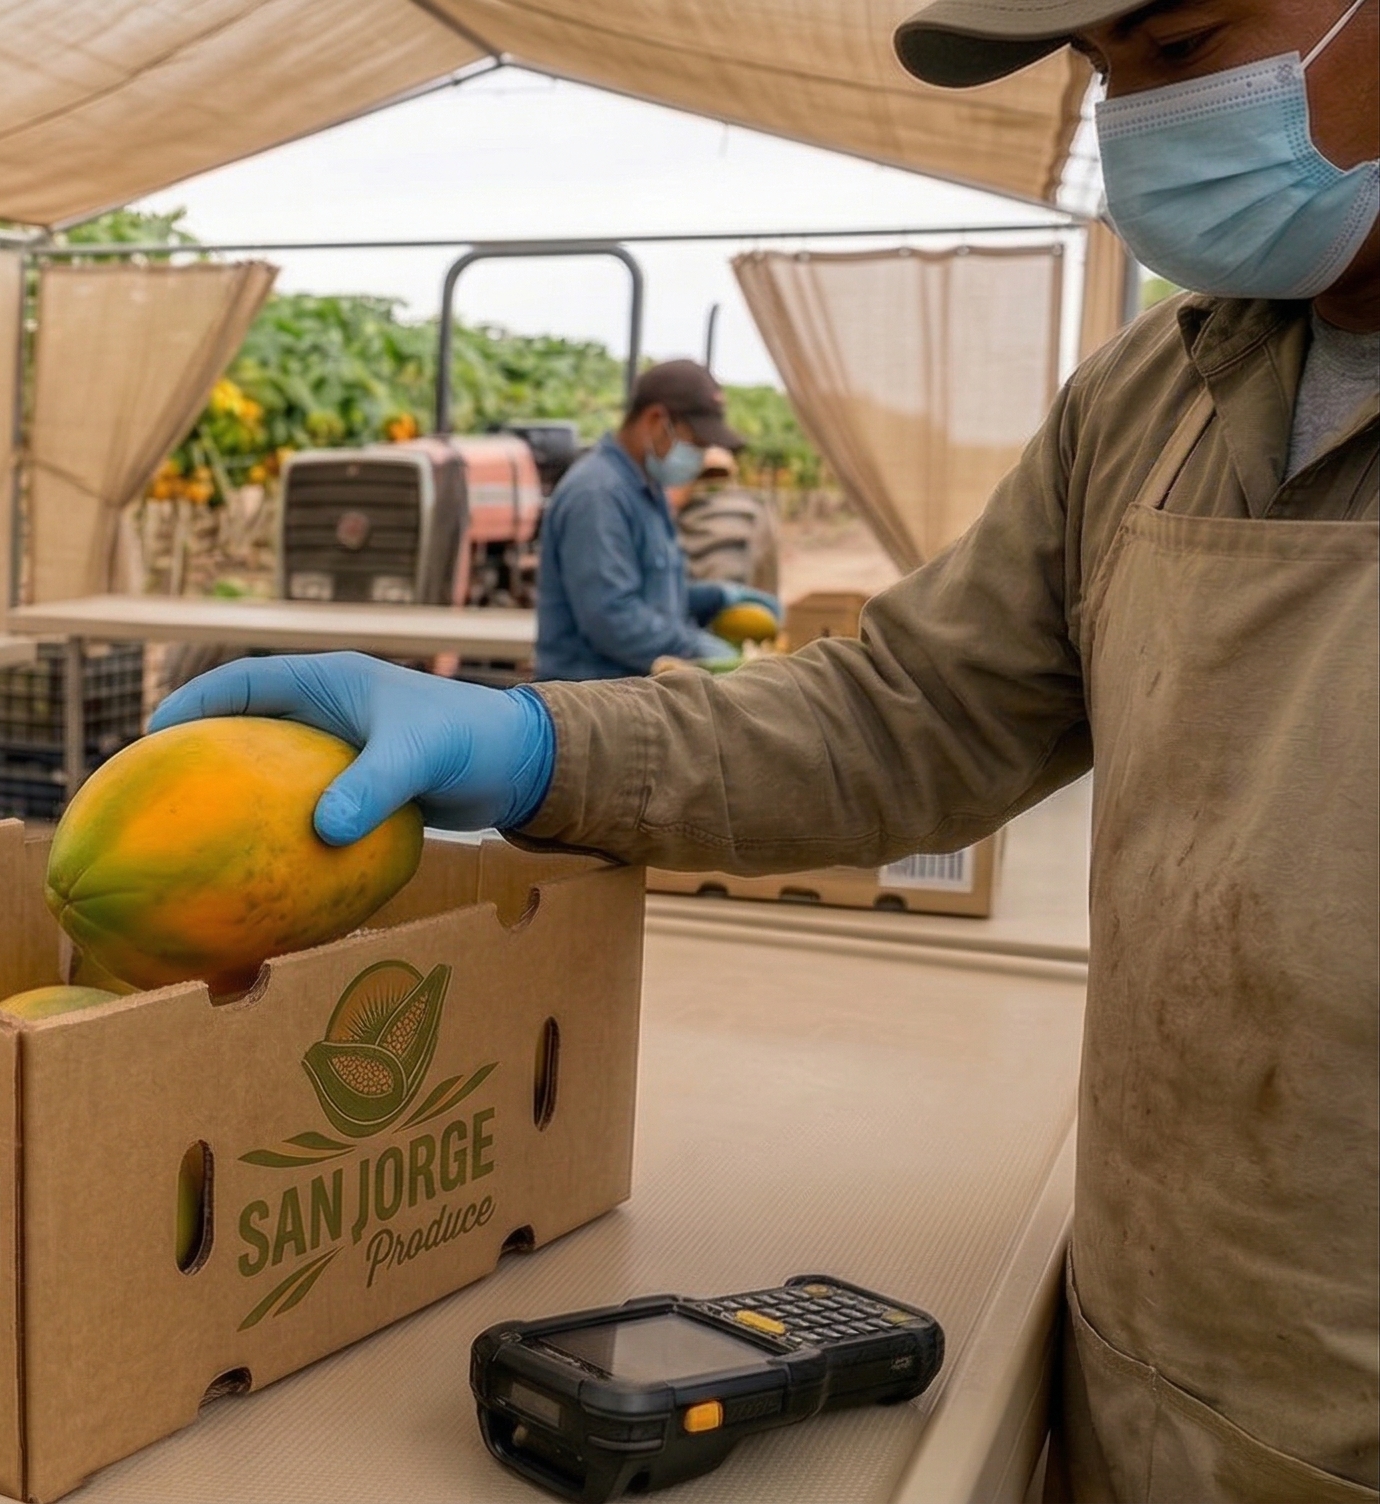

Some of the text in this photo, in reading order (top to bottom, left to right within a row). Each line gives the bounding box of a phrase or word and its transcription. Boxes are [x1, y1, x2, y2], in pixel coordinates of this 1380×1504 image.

[237, 1107, 495, 1278] SAN JORGE
[366, 1194, 497, 1289] Produce
